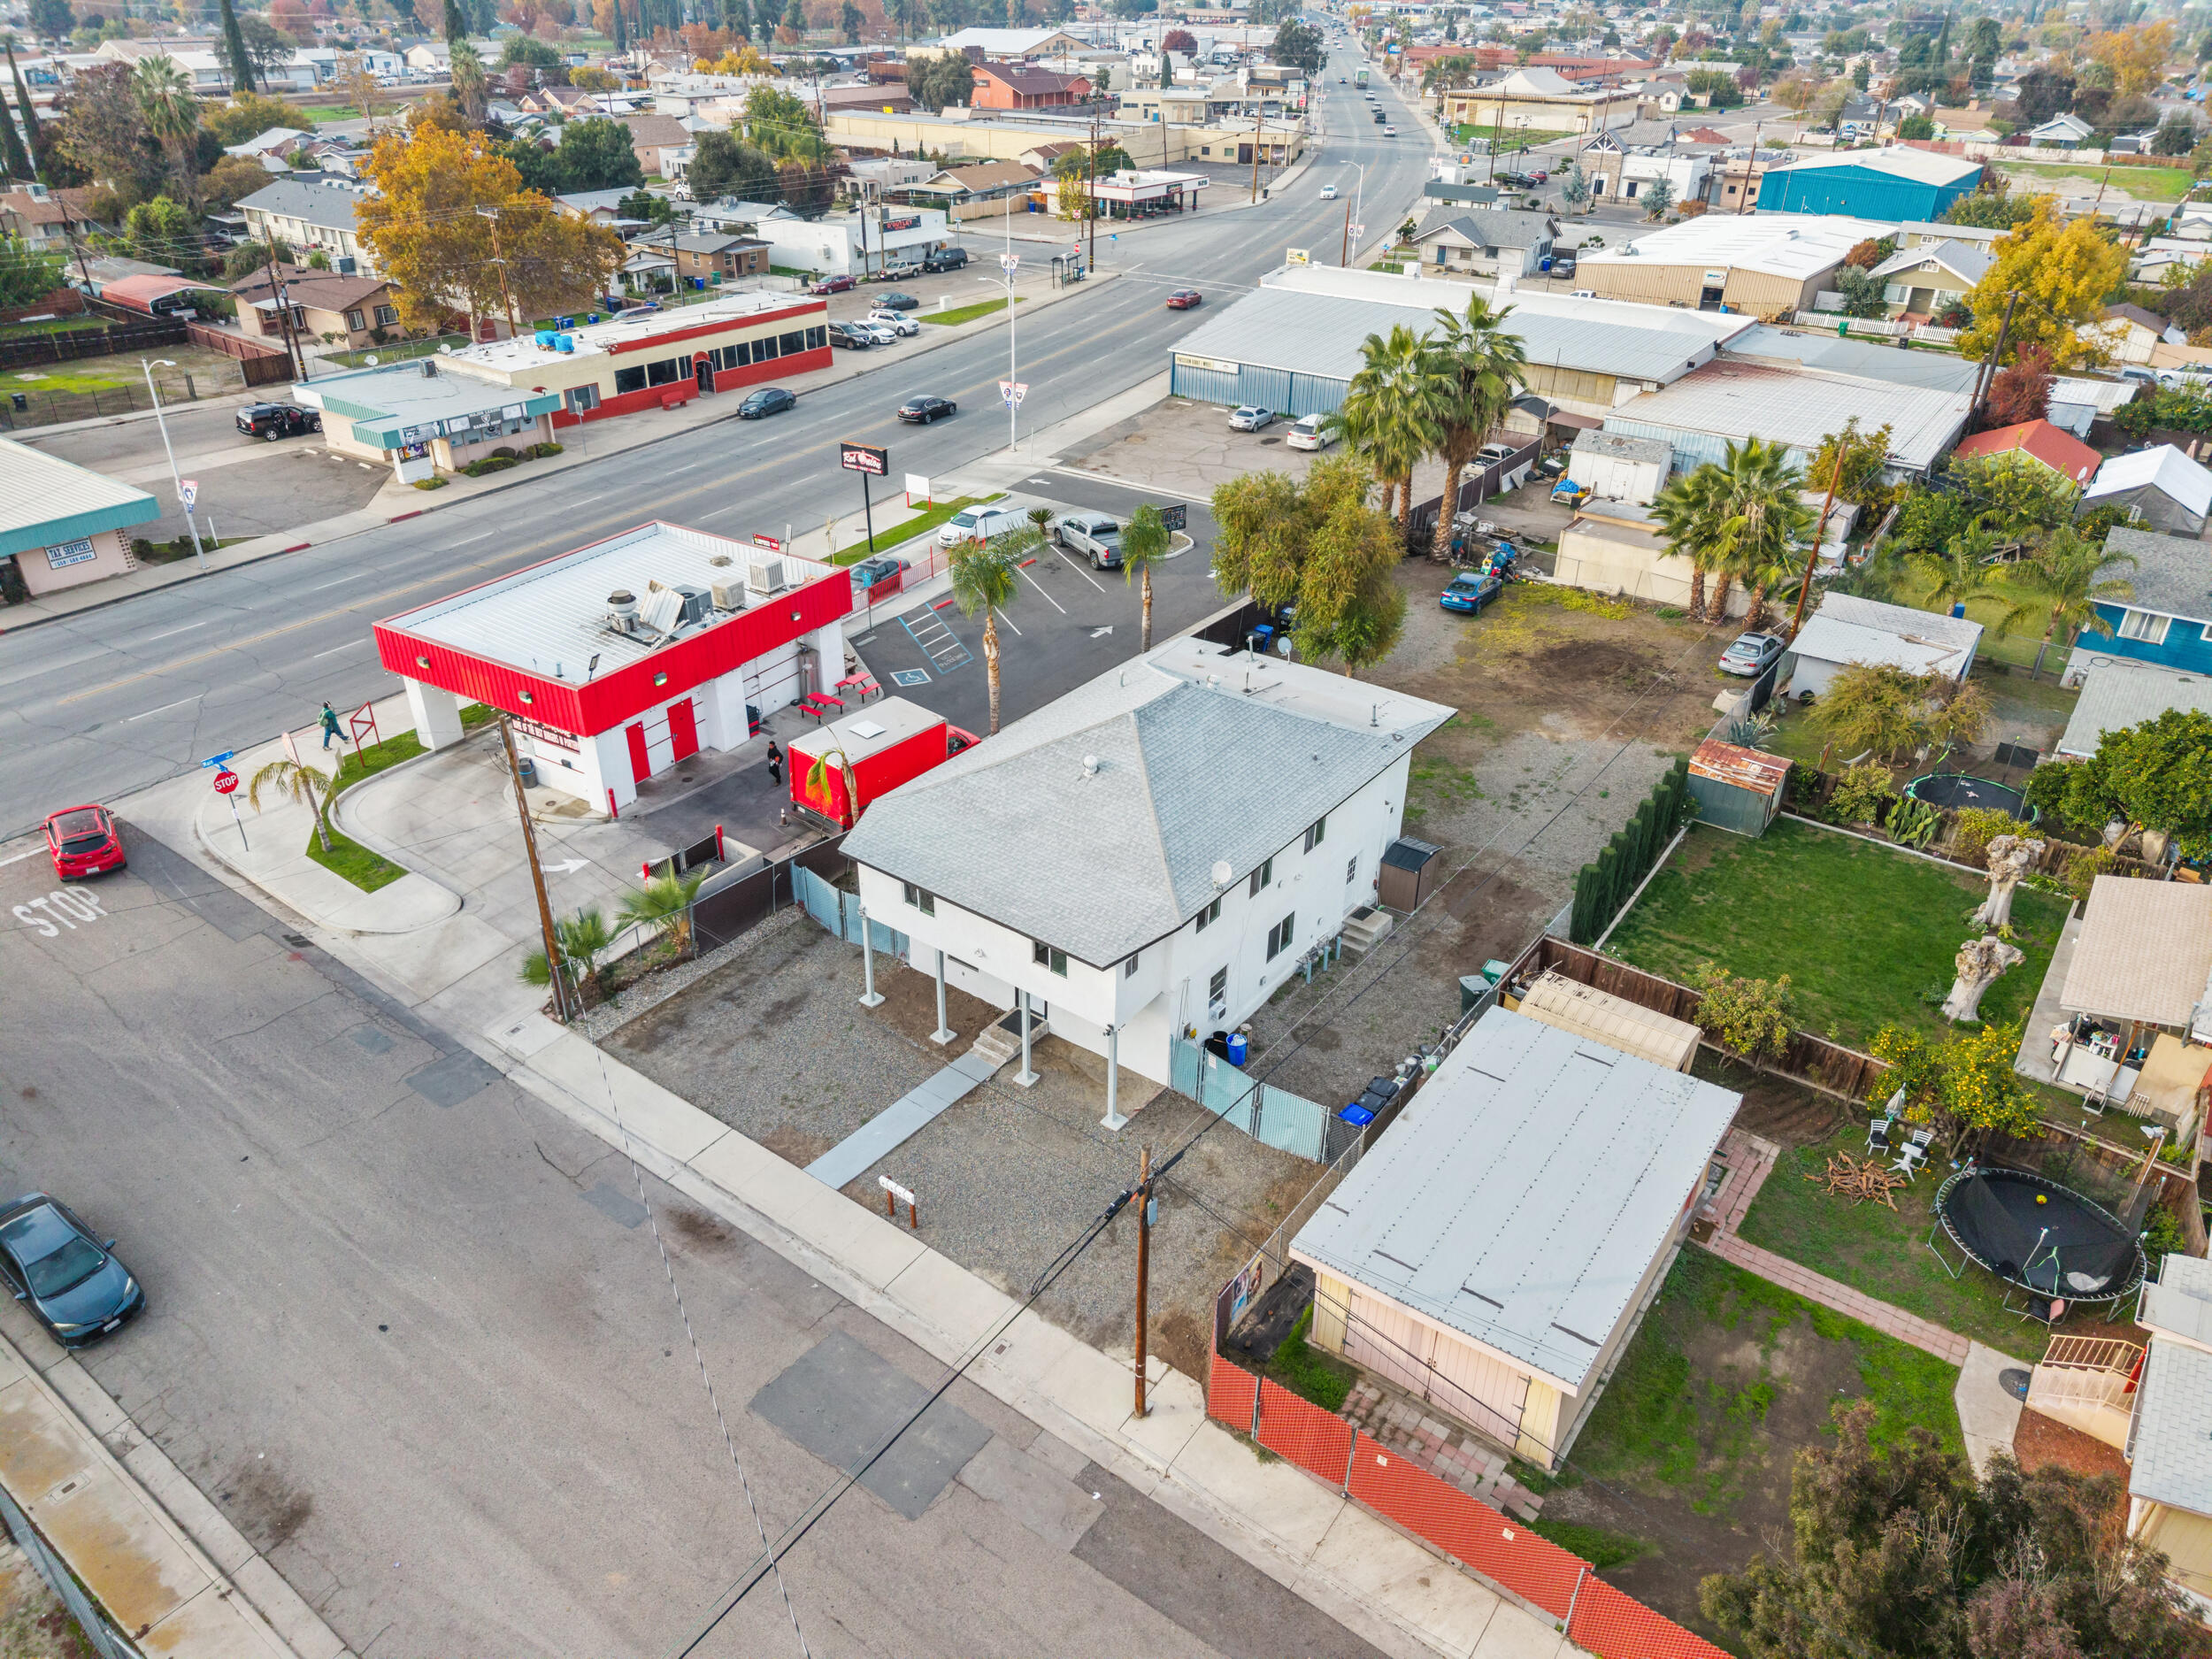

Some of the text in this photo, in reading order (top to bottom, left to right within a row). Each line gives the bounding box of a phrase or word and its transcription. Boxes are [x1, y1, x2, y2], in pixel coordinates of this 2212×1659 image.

[49, 541, 90, 558] TAX SERVICES
[215, 774, 236, 790] STOP
[12, 886, 108, 937] STOP
